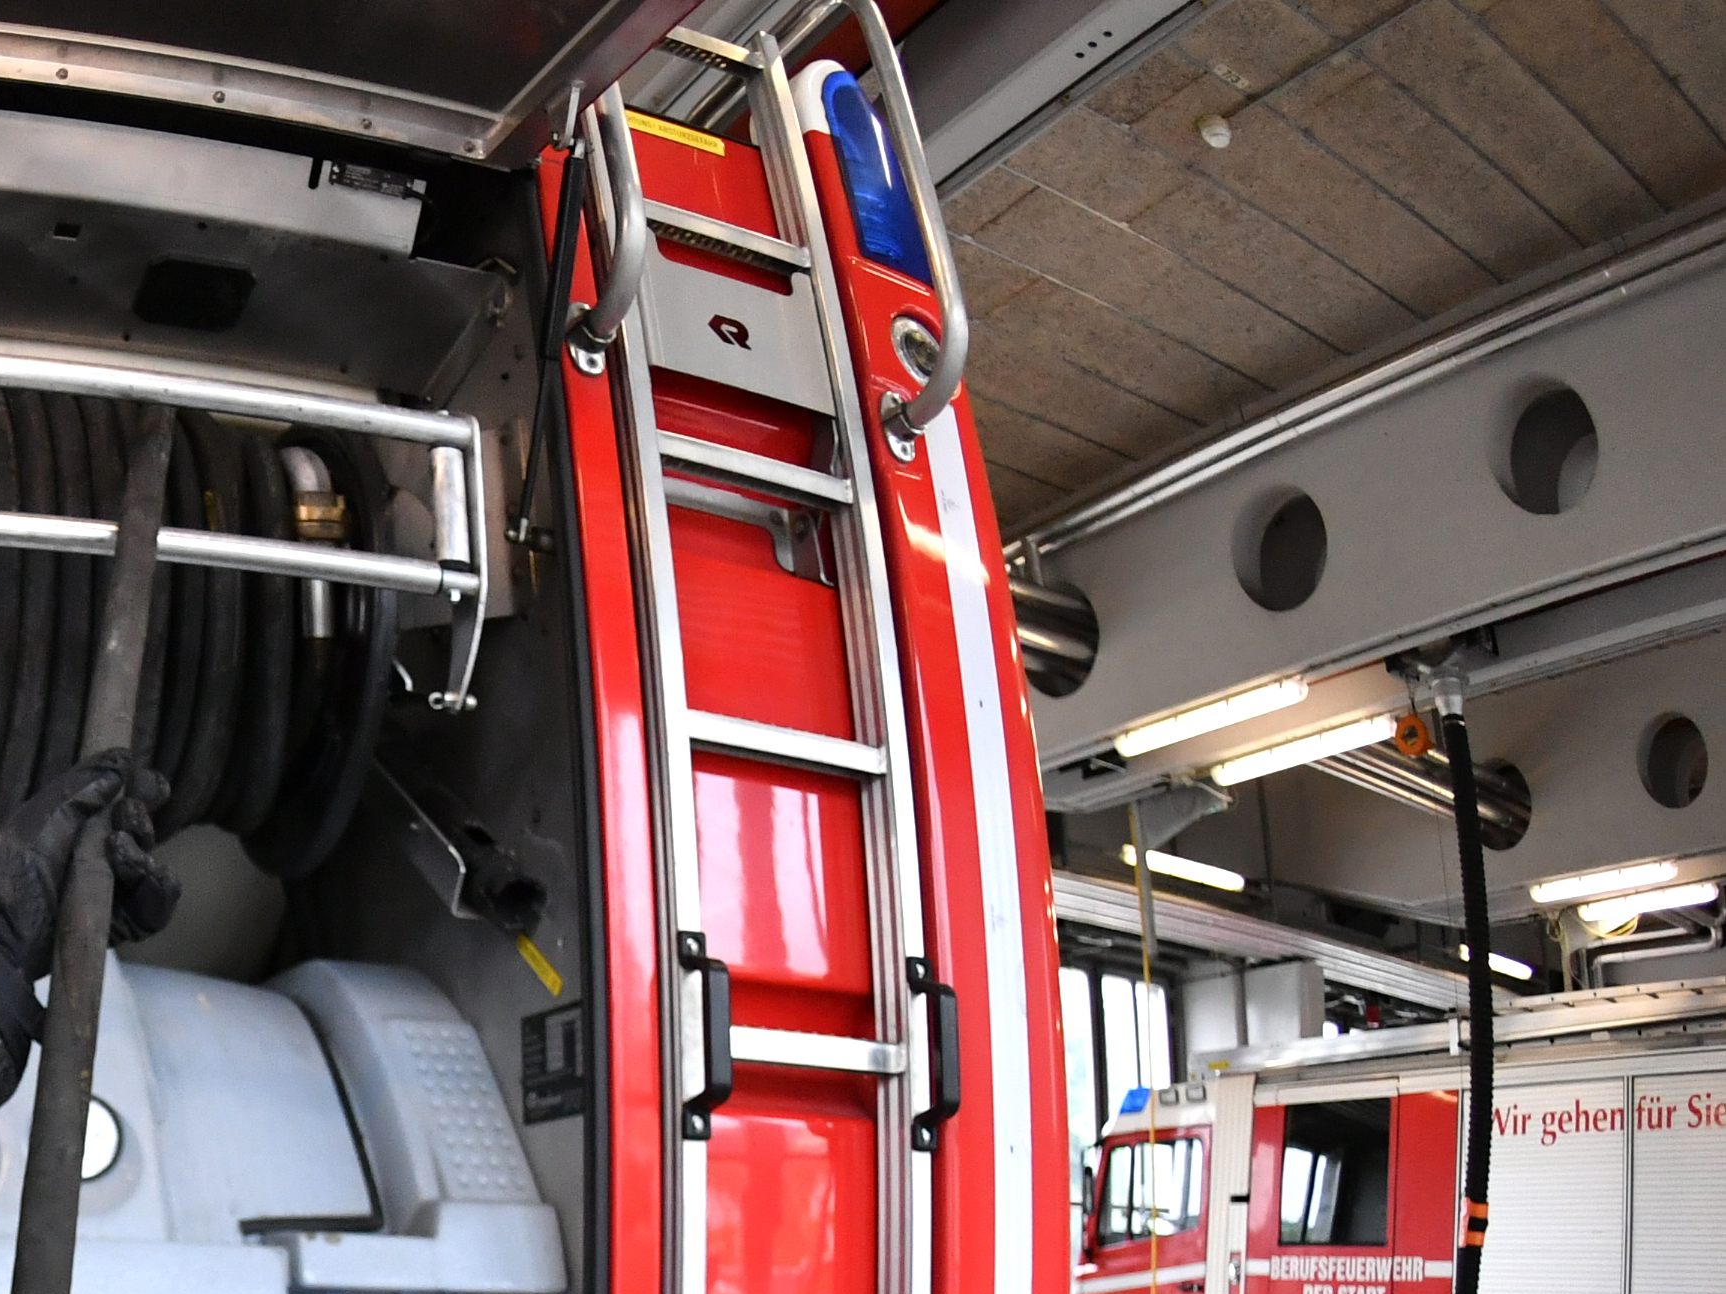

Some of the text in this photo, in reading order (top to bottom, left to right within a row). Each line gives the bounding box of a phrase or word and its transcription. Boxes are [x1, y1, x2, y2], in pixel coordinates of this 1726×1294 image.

[1540, 1098, 1624, 1147] gehen
[1635, 1095, 1677, 1131] für
[1687, 1092, 1726, 1129] Sie
[1270, 1255, 1424, 1282] BERUFSFEUERWEHR
